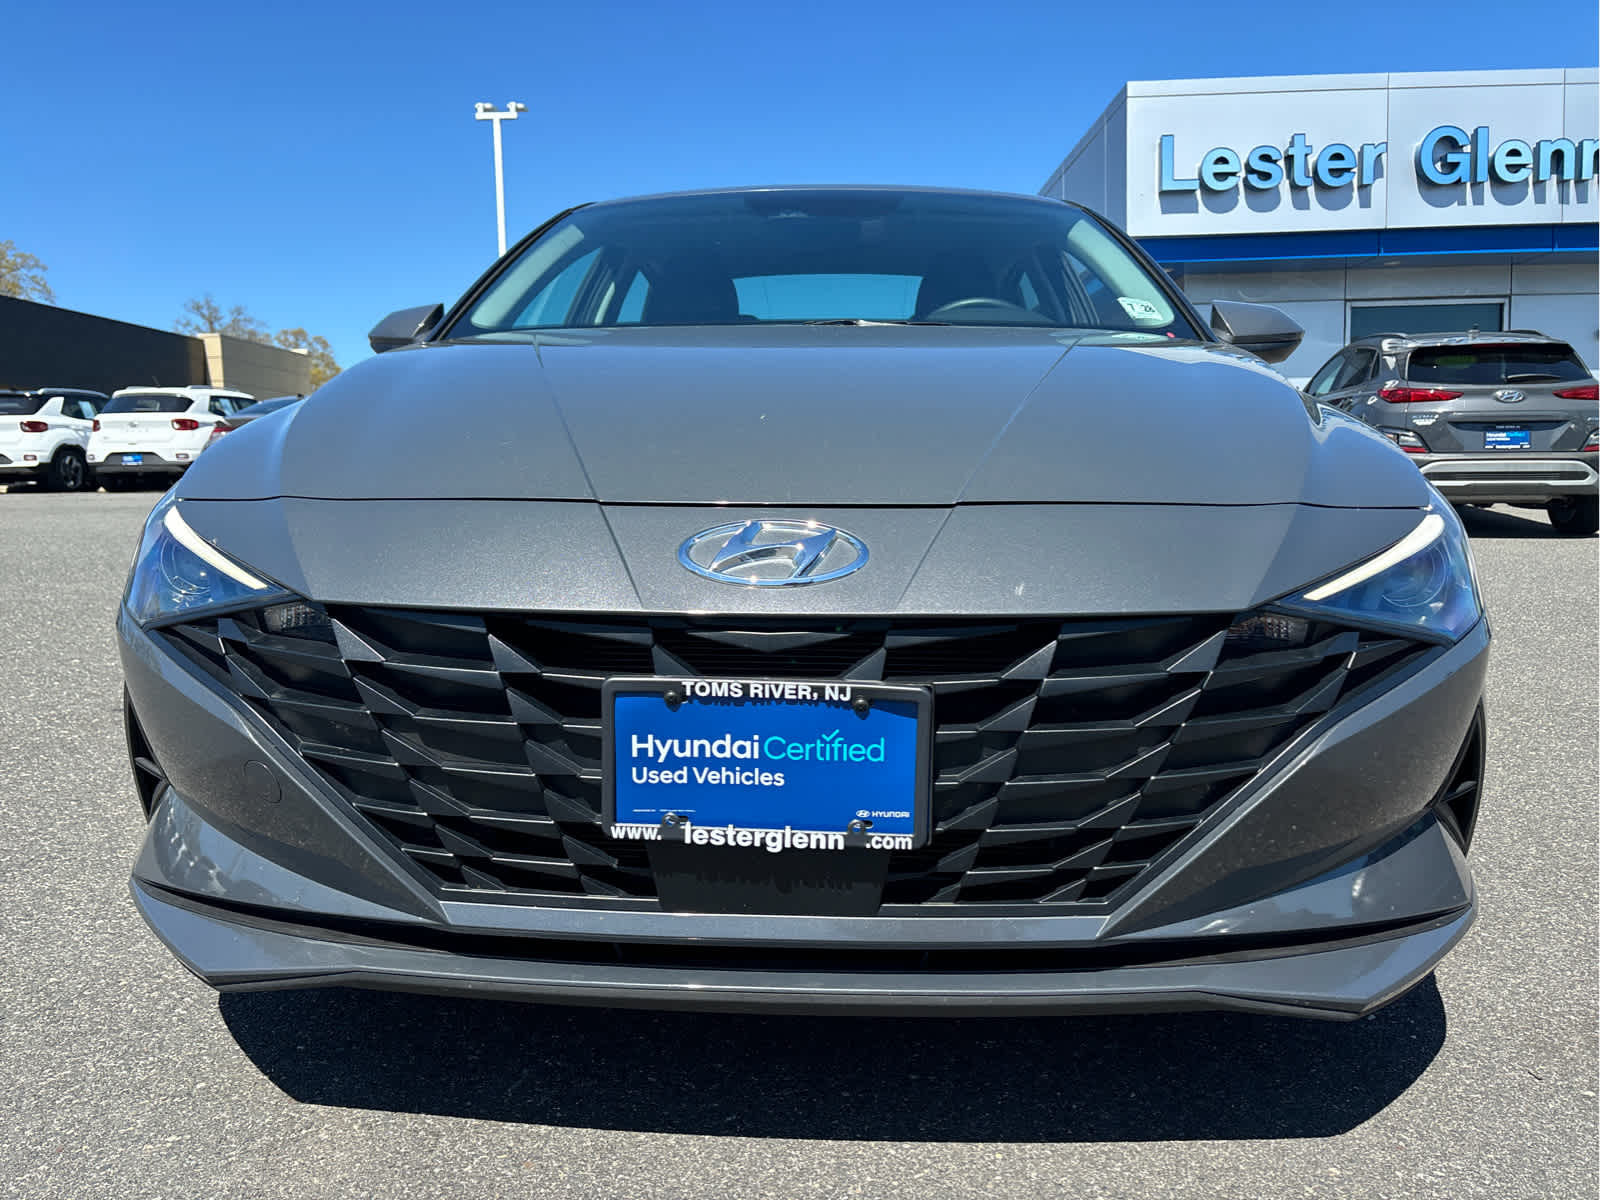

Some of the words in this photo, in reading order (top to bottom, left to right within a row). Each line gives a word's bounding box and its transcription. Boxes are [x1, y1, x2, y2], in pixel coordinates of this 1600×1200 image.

[1158, 133, 1388, 192] Lester
[682, 681, 743, 697] TOMS
[750, 683, 818, 701] RIVER,
[824, 685, 851, 701] NJ
[631, 733, 760, 763] Hyundai
[763, 729, 886, 762] Certified
[631, 766, 688, 785] Used
[692, 767, 785, 786] Vehicles
[871, 810, 910, 818] HYUNDAI
[610, 825, 662, 840] www.
[684, 821, 845, 853] lesterglenn
[865, 835, 913, 850] .com
